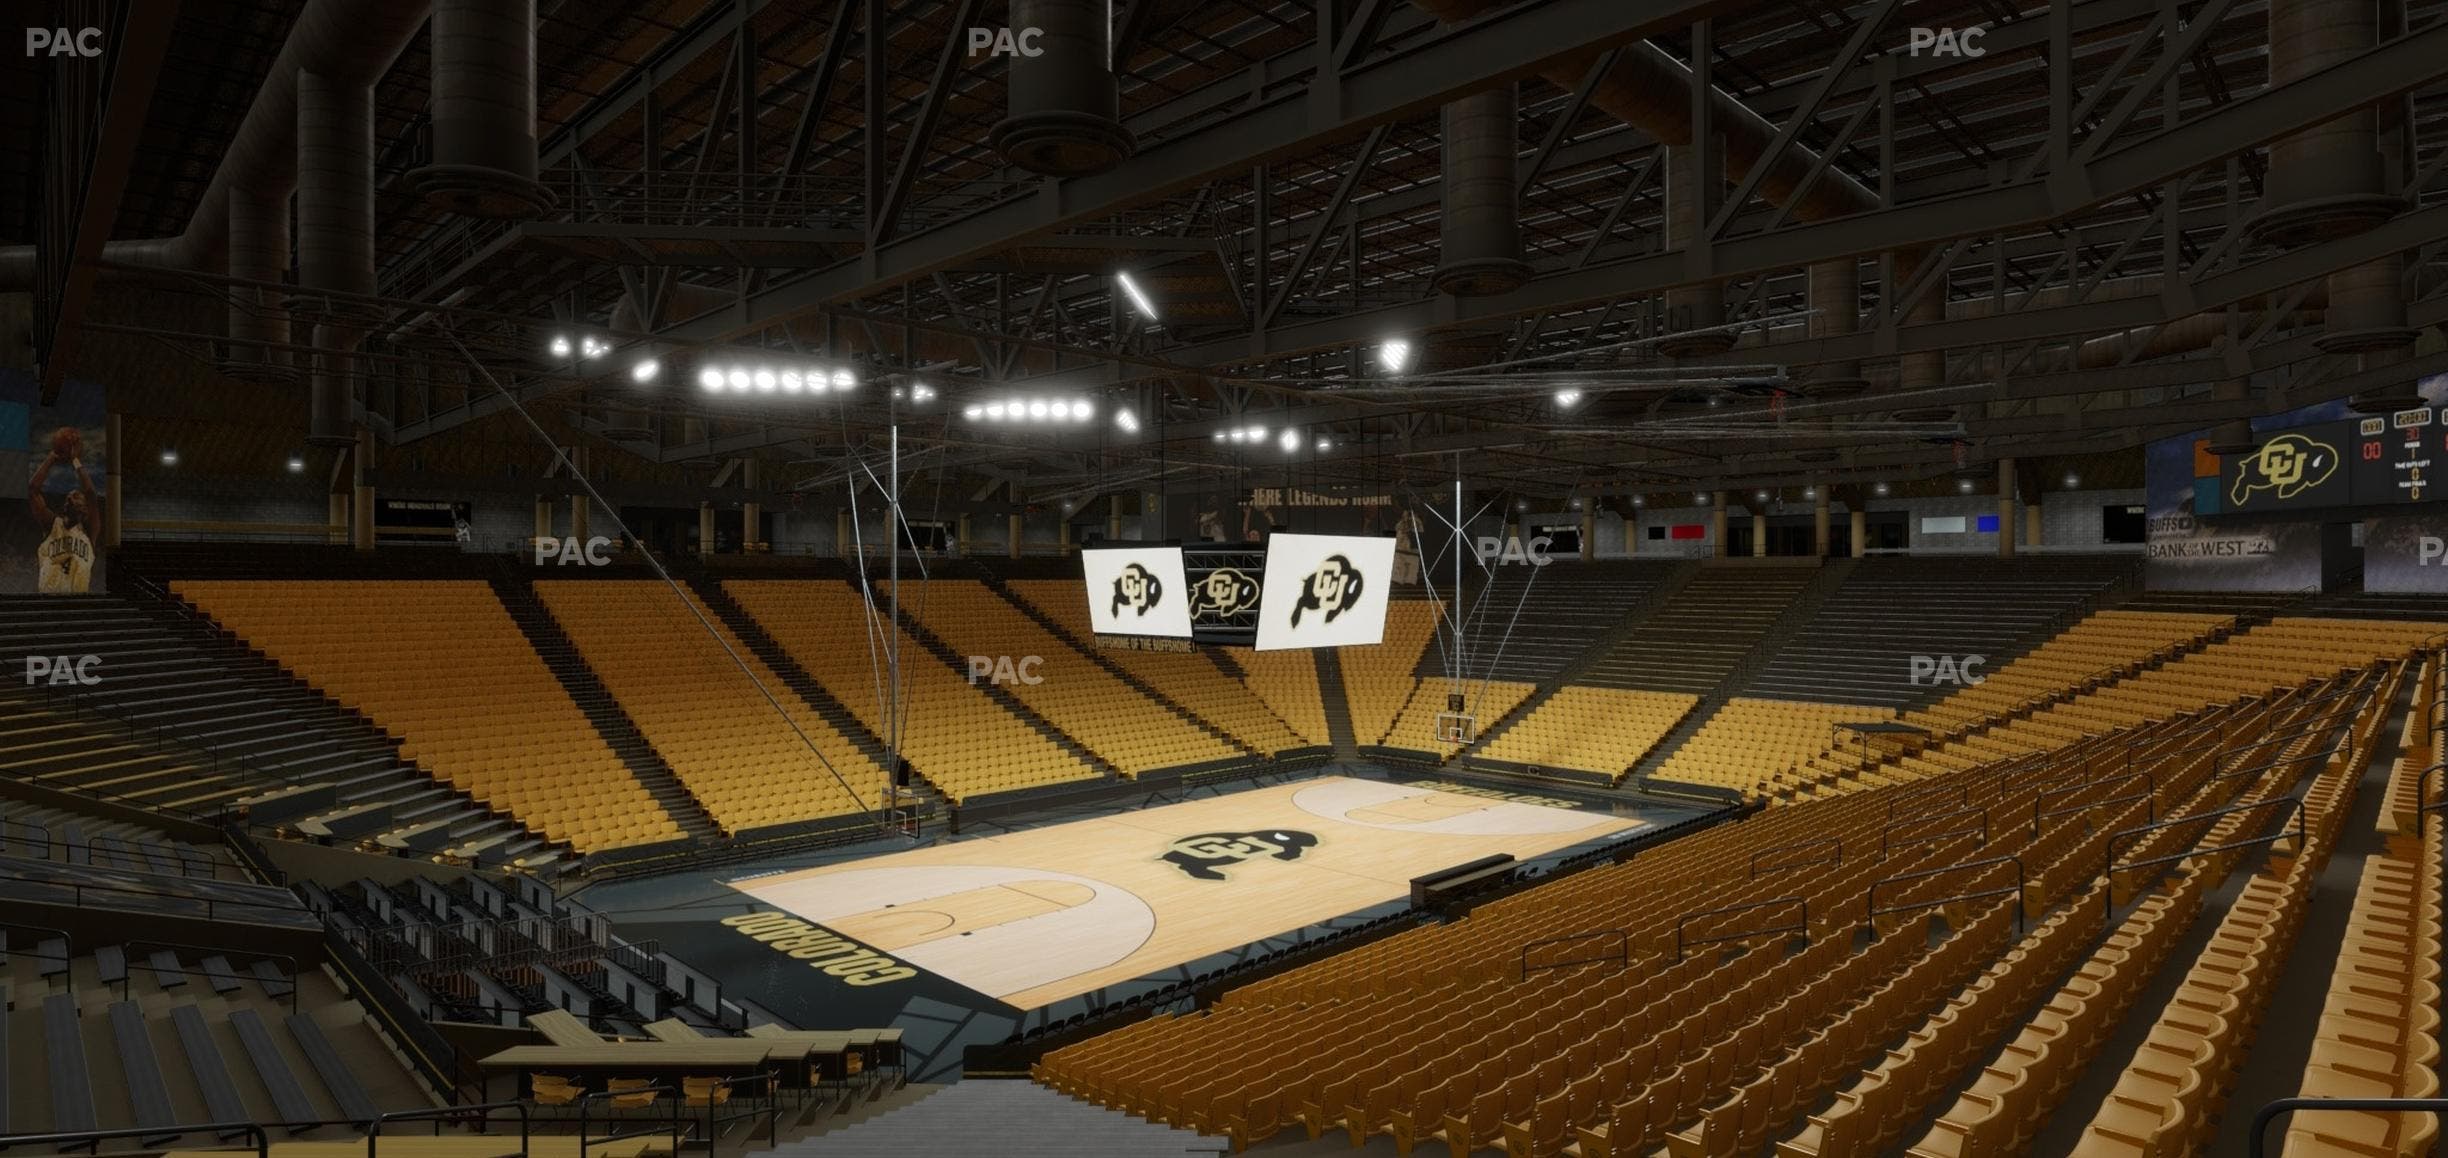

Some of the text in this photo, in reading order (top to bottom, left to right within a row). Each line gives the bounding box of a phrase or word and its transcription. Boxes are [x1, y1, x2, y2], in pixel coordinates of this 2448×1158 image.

[2363, 441, 2381, 460] 00
[2411, 467, 2419, 480] 0
[2411, 487, 2419, 500] 0
[2148, 543, 2187, 559] BANK
[2201, 540, 2245, 556] WEST
[720, 911, 918, 987] COLORADO
